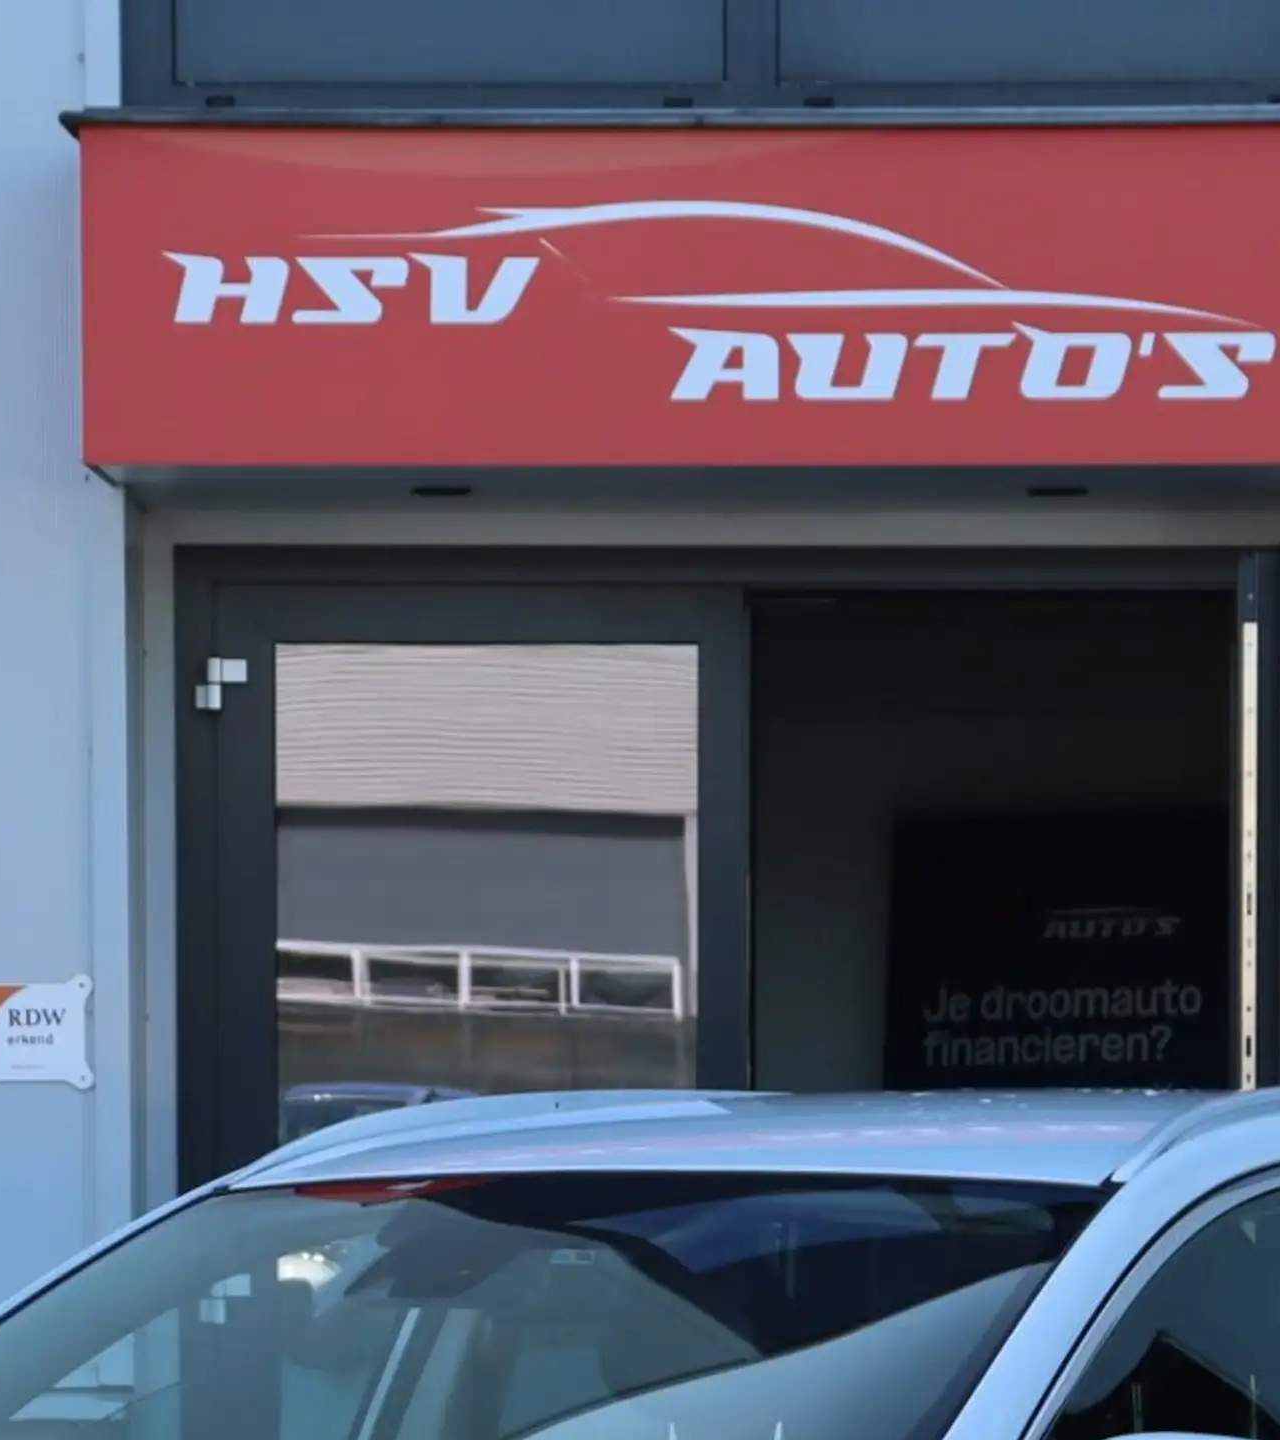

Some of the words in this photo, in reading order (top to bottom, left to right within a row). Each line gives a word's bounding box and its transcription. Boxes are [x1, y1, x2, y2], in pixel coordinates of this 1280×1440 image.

[161, 251, 540, 324] HSV
[666, 320, 1276, 401] AUTO'S
[1042, 917, 1181, 938] AUTOS
[8, 1008, 66, 1026] RDW
[922, 984, 971, 1022] Je
[980, 979, 1203, 1022] droomauto
[922, 1023, 1174, 1067] financieren?
